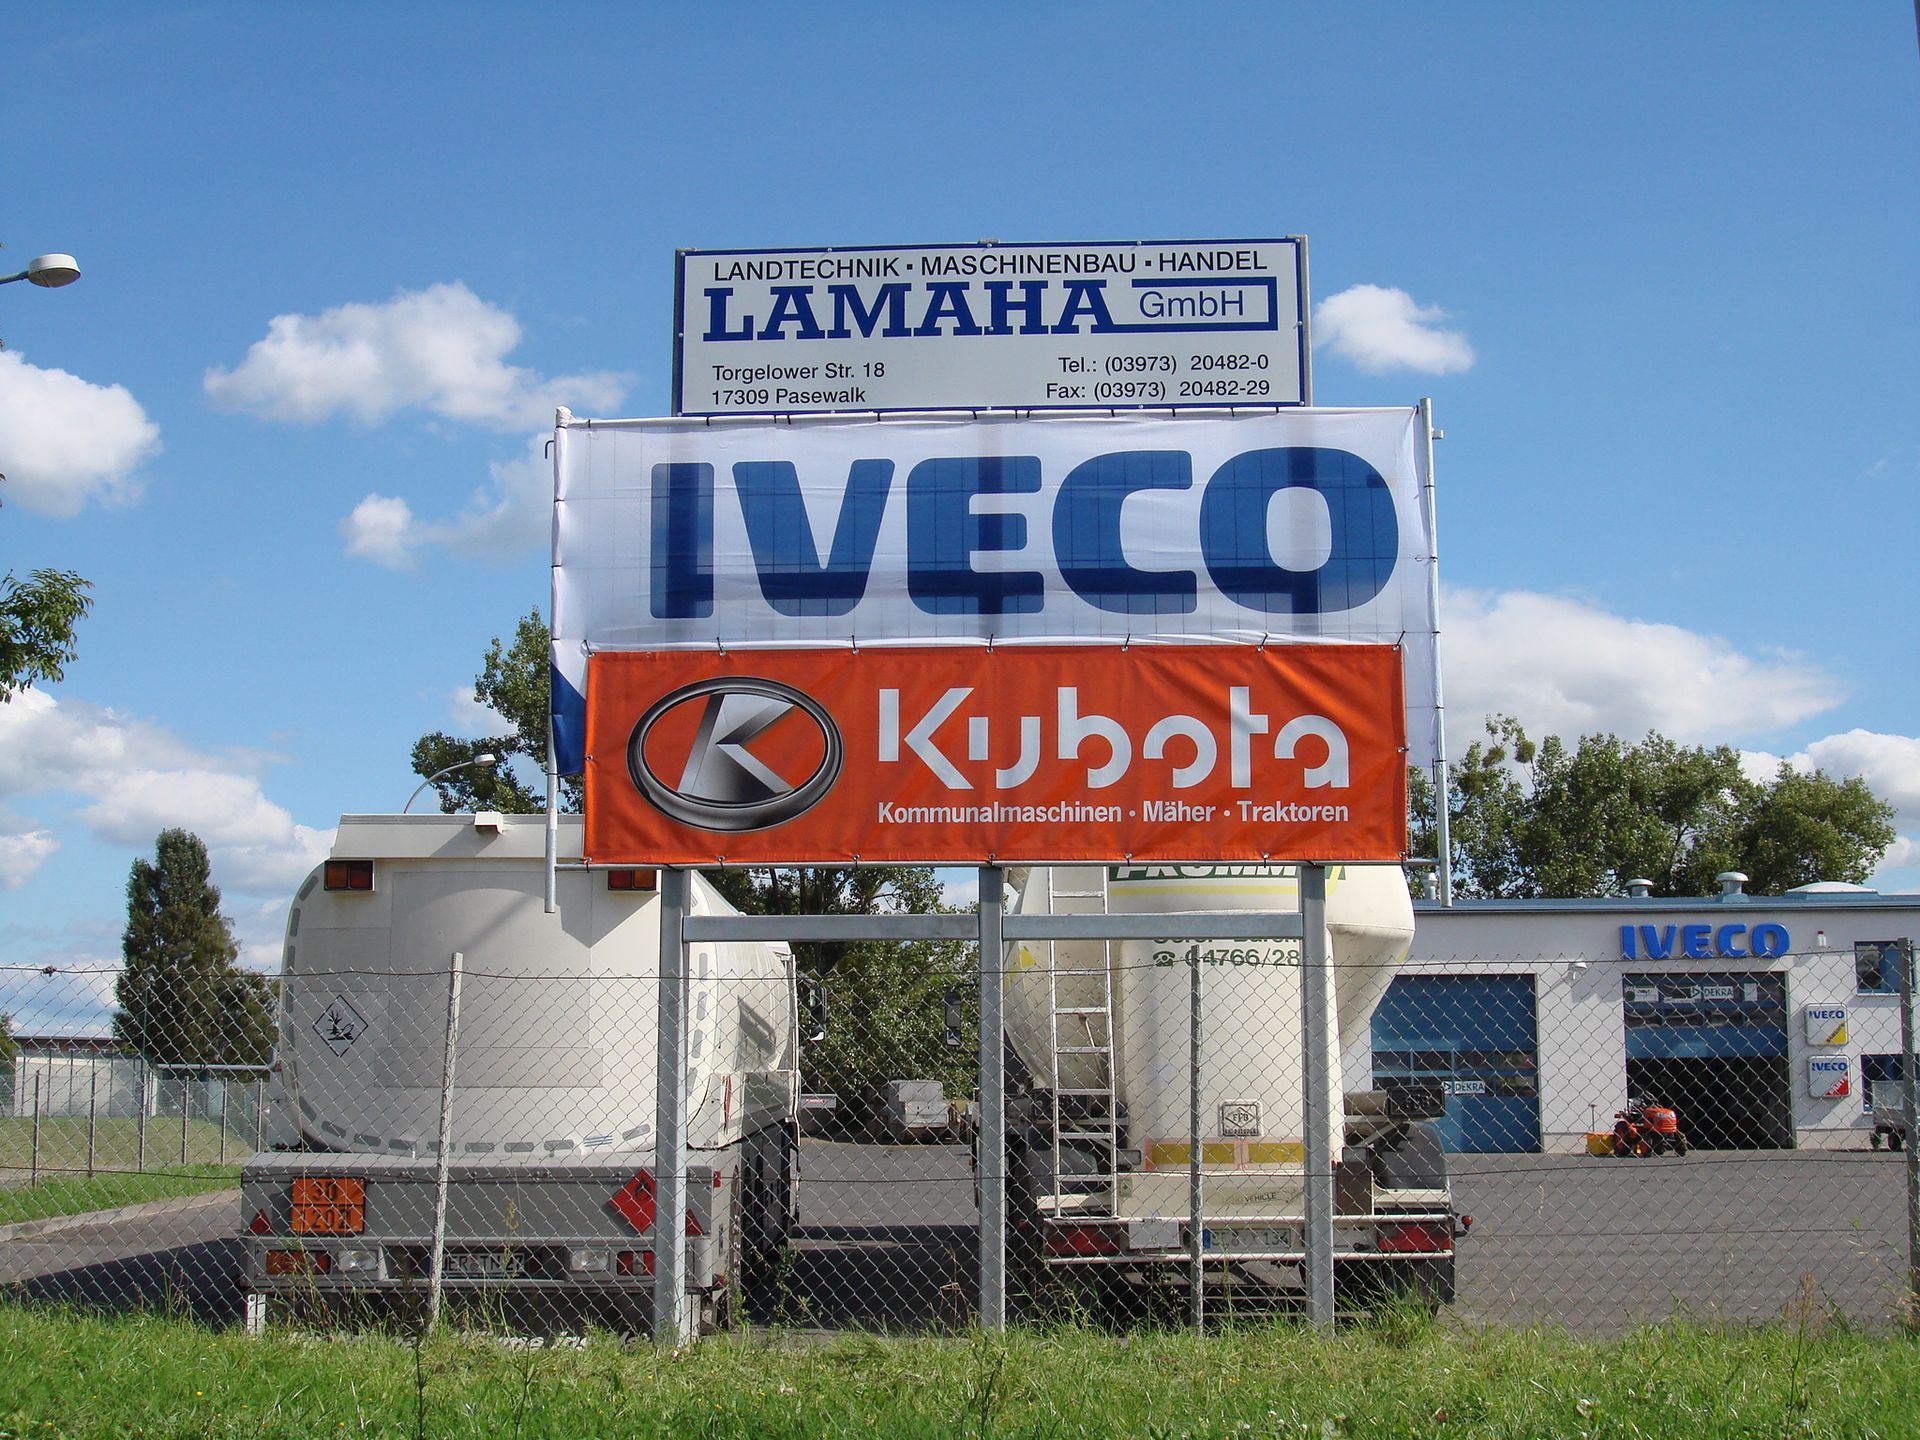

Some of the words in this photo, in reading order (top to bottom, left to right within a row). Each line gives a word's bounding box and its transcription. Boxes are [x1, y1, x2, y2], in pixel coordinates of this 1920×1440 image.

[714, 257, 898, 281] LANDTECHNIK
[921, 252, 1136, 275] MASCHINENBAU
[1159, 251, 1268, 272] HANDEL
[703, 279, 1115, 342] LAMAHA
[1139, 289, 1245, 317] GmbH
[711, 363, 819, 385] Torgelower
[824, 362, 856, 379] Str.
[862, 362, 885, 378] 18
[1057, 356, 1098, 373] Tel.:
[1105, 354, 1177, 376] (03973)
[1190, 354, 1269, 371] 20482-0
[711, 388, 769, 406] 17309
[776, 386, 866, 404] Pasewalk
[1046, 382, 1087, 399] Fax:
[1094, 381, 1166, 401] (03973)
[1180, 380, 1270, 397] 20482-29
[650, 447, 1399, 619] IVECO
[878, 686, 1350, 790] Kubota
[878, 800, 1122, 824] Kommunalmaschinen
[1143, 800, 1216, 822] Mäher
[1236, 800, 1349, 822] Traktoren
[1620, 923, 1790, 960] IVECO
[1704, 986, 1733, 998] DEKRA
[1809, 1010, 1845, 1019] IVECO
[1812, 1062, 1848, 1071] IVECO
[1455, 1082, 1485, 1092] DEKRA
